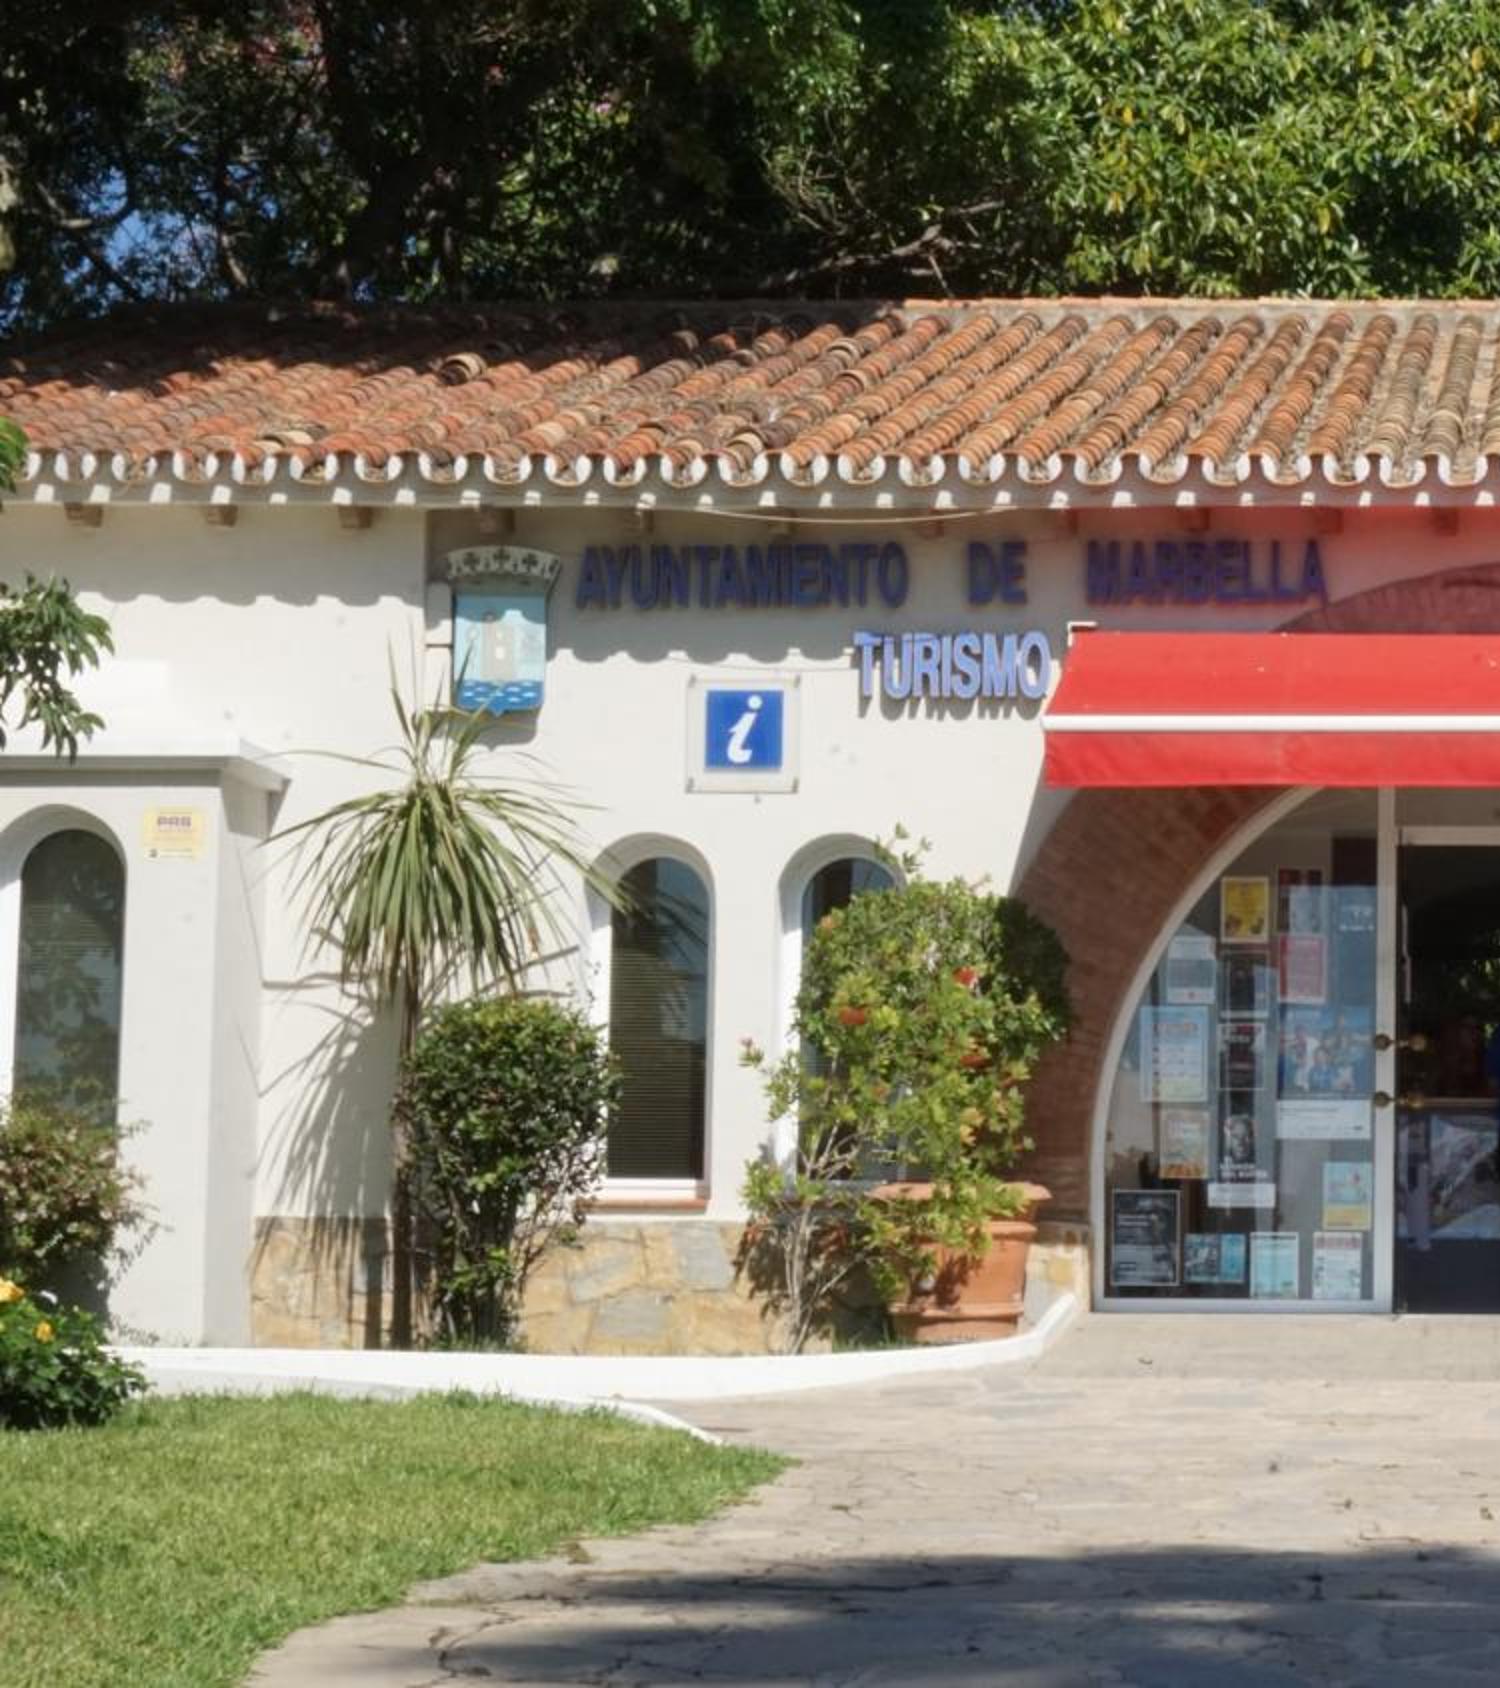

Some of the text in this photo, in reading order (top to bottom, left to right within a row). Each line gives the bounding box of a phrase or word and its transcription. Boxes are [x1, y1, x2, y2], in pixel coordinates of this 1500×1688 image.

[576, 539, 1328, 609] AYUNTAMIENTO DE MARBELLA
[853, 631, 1050, 699] TURISMO
